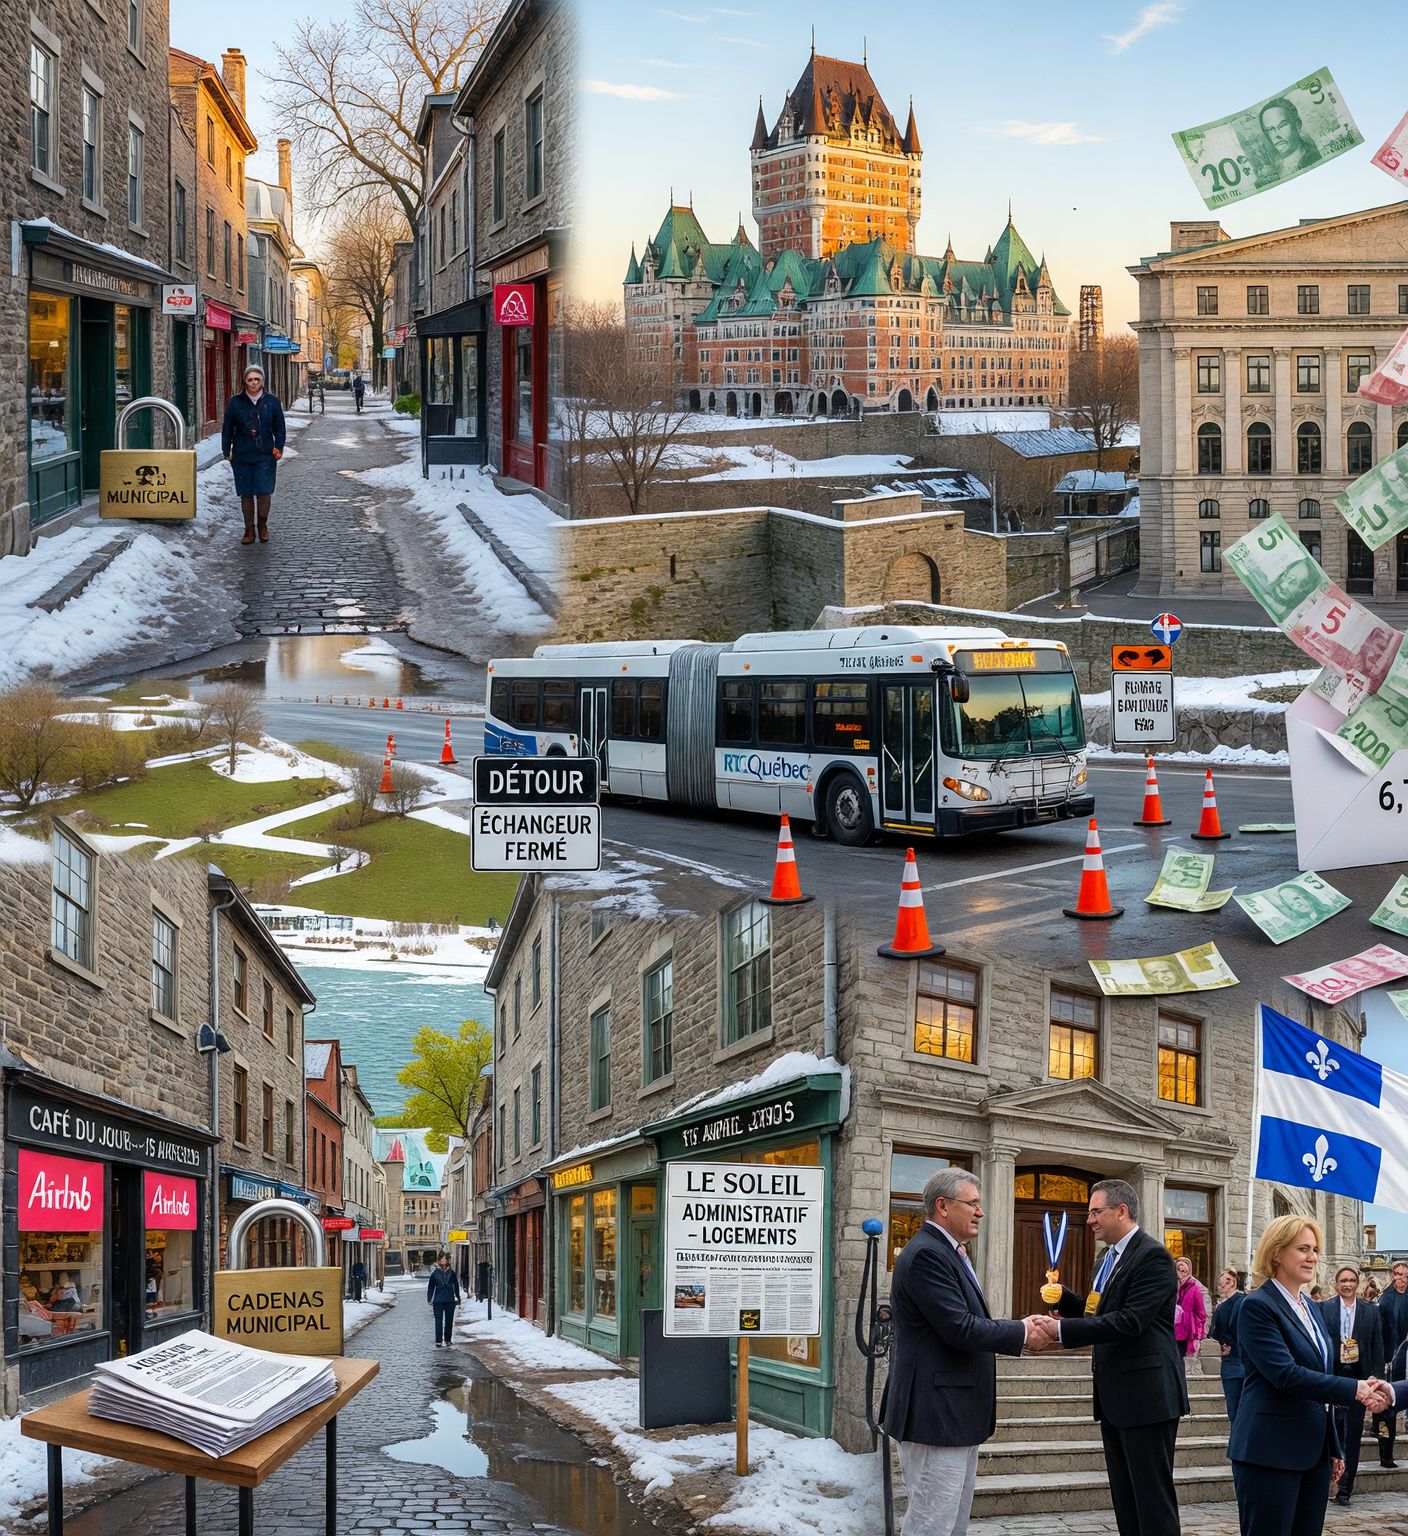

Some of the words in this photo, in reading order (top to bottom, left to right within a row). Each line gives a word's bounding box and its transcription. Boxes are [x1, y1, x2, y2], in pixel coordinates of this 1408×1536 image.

[107, 489, 189, 504] MUNICIPAL
[489, 762, 584, 795] DÉTOUR
[479, 810, 592, 835] ÉCHANGEUR
[505, 837, 567, 861] FERMÉ
[29, 1105, 72, 1138] CAFÉ
[76, 1117, 95, 1144] DU
[686, 1170, 716, 1193] LE
[723, 1172, 806, 1196] SOLEIL
[682, 1203, 809, 1224] ADMINISTRATIF
[702, 1226, 797, 1246] LOGEMENTS
[227, 1290, 325, 1312] CADENAS
[226, 1313, 331, 1335] MUNICIPAL
